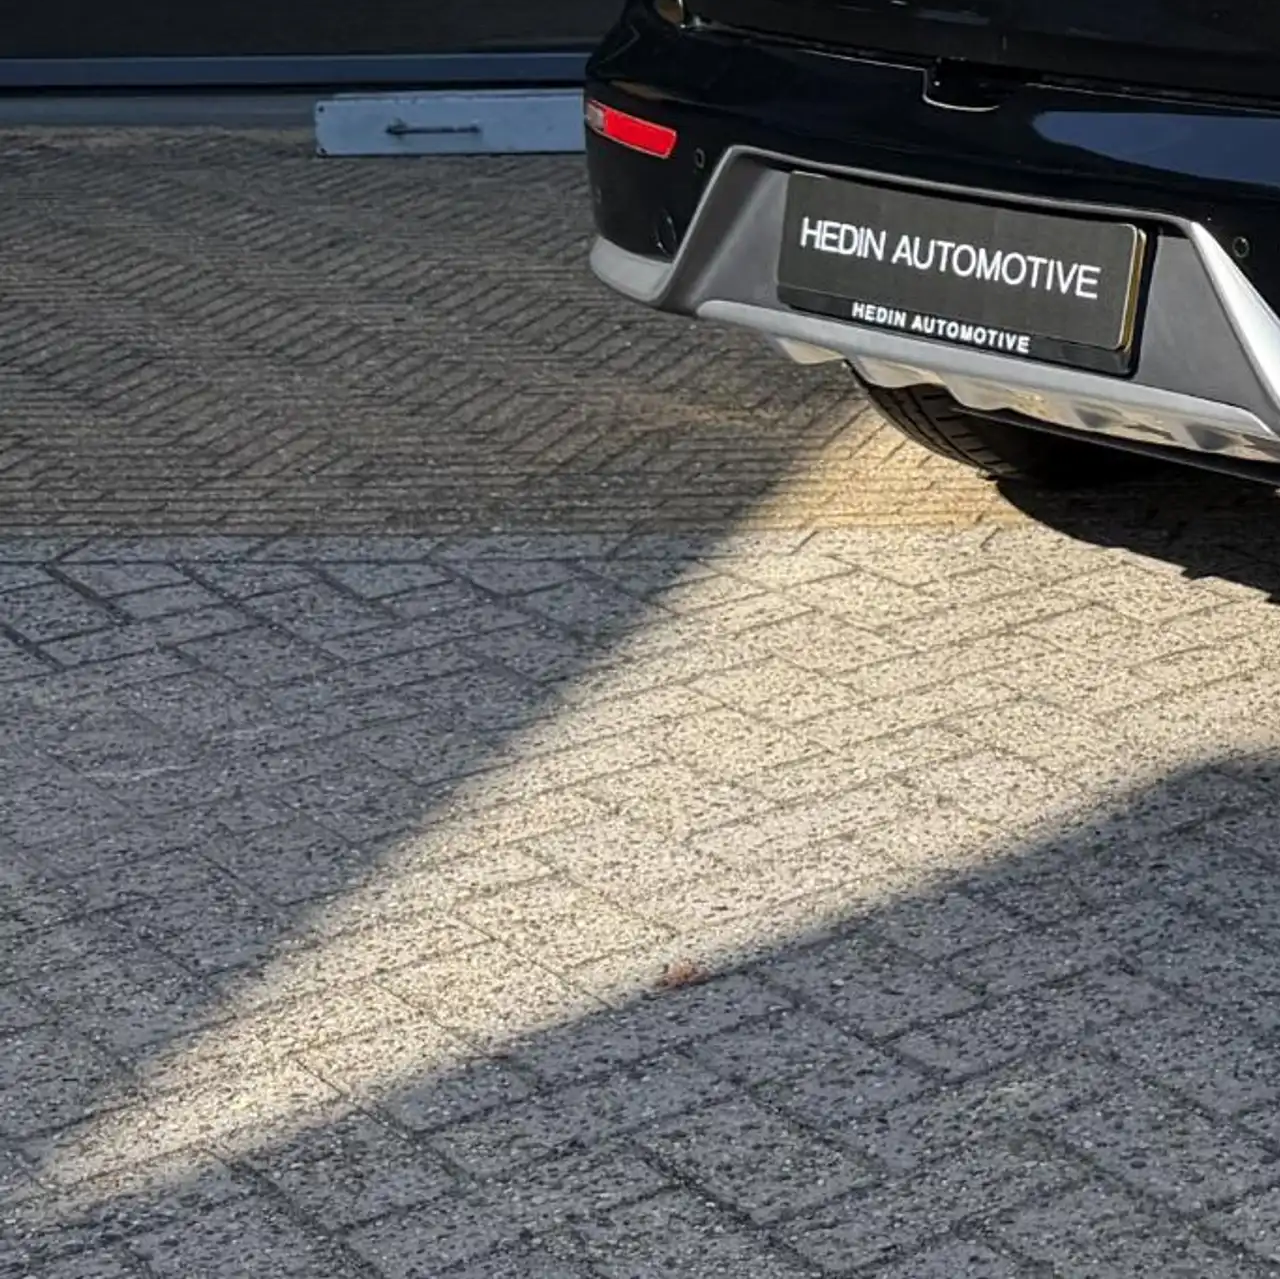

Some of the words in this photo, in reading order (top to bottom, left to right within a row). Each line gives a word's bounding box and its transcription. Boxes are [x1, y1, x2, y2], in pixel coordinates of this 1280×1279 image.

[800, 216, 887, 261] HEDIN
[891, 234, 1101, 299] AUTOMOTIVE
[851, 301, 907, 328] HEDIN
[911, 314, 1031, 354] AUTOMOTIVE
